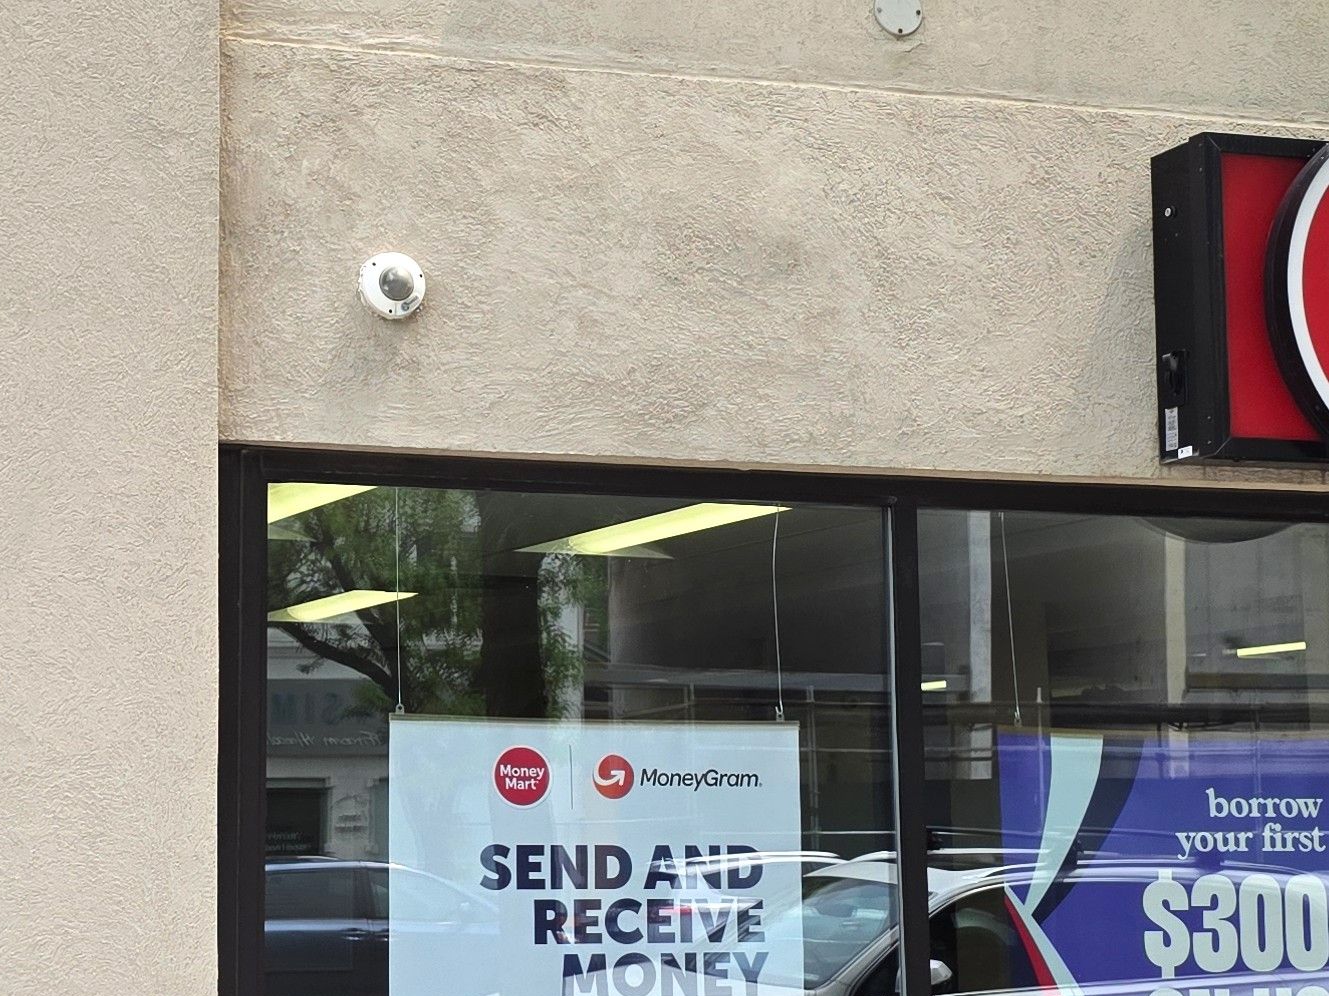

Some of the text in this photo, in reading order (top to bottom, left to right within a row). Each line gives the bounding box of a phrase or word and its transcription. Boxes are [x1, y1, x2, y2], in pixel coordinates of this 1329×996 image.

[499, 764, 545, 781] Money
[505, 777, 537, 790] Mart
[1205, 787, 1324, 818] borrow
[1175, 822, 1327, 860] your first
[479, 844, 764, 891] SEND AND
[534, 898, 766, 945] RECEIVE
[1142, 868, 1329, 979] $300
